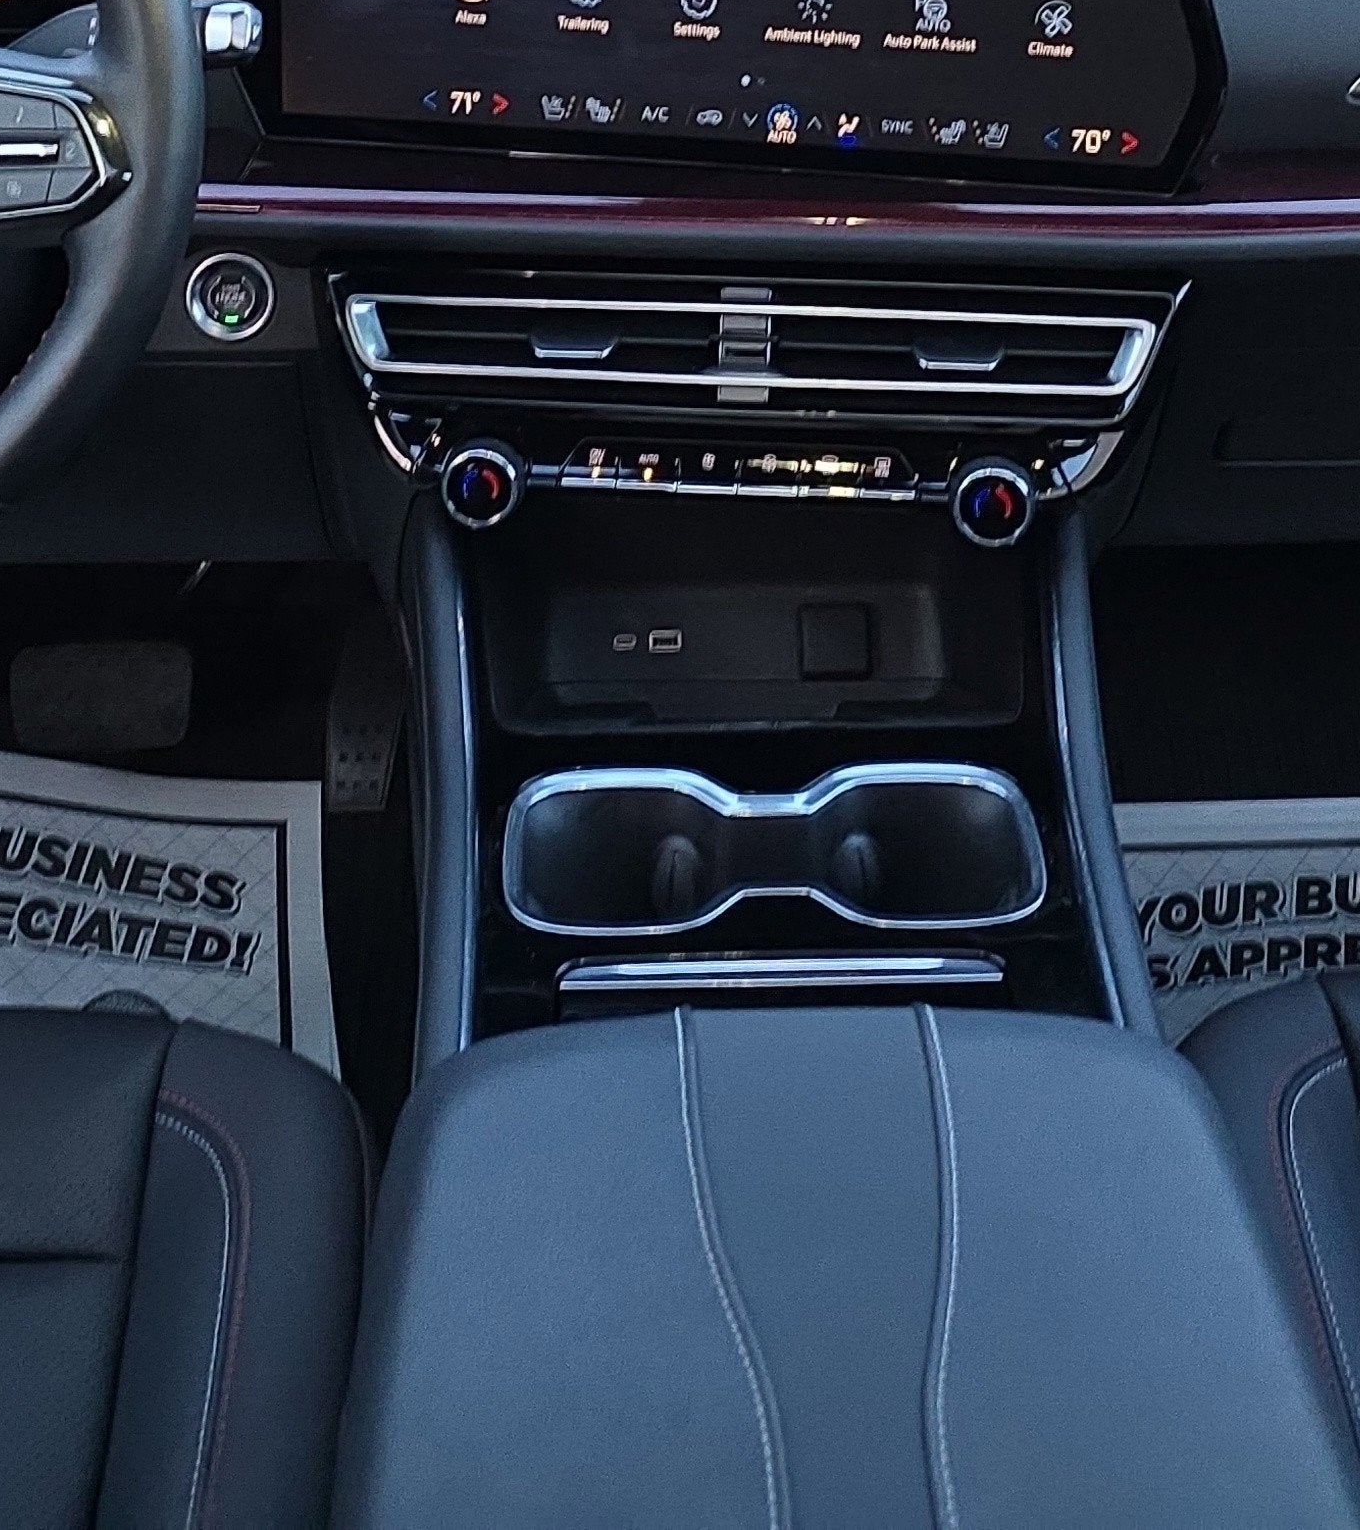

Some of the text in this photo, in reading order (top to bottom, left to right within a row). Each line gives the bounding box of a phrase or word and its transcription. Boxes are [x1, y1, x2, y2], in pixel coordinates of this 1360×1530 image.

[454, 10, 487, 25] Alexa
[557, 14, 610, 35] Trailering
[673, 21, 721, 40] Settings
[763, 26, 861, 49] Ambient Lighting
[883, 33, 977, 52] Auto Park Assist
[1027, 41, 1074, 57] Climate
[642, 105, 670, 122] A/C
[880, 118, 914, 135] SYNC
[766, 130, 797, 144] AUTO
